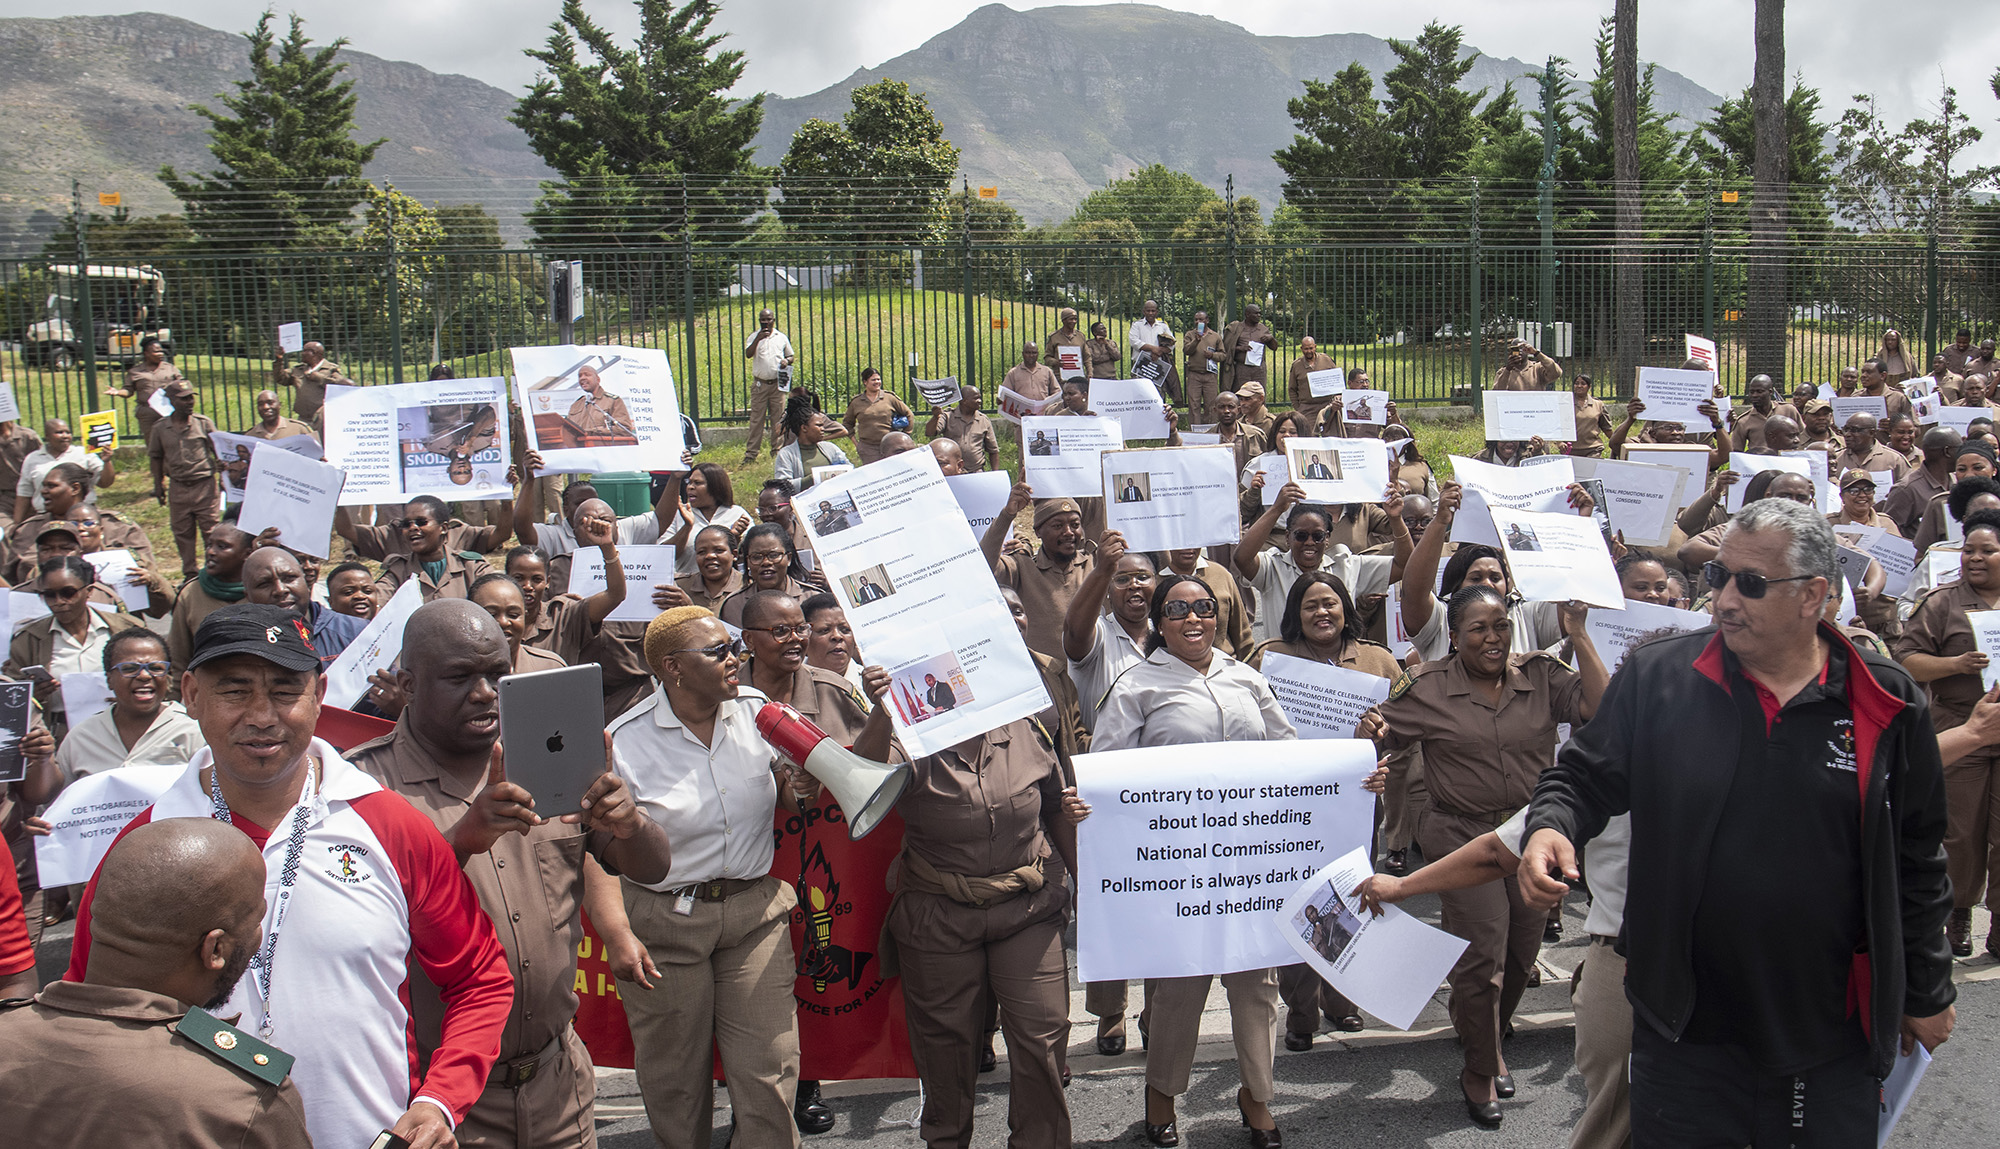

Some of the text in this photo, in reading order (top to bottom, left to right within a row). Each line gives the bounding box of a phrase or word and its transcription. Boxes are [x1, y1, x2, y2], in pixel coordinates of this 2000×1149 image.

[898, 475, 918, 485] DESERVE
[858, 492, 889, 505] PUNISHMENT?
[885, 491, 910, 503] HARDWORK
[911, 483, 931, 494] WITHOUT
[1492, 492, 1534, 501] PROMOTIONS
[1534, 488, 1554, 496] MUST
[863, 508, 879, 517] UNJUST
[890, 497, 912, 507] INHUMAN
[968, 517, 995, 527] OTIO
[930, 560, 946, 568] HOURS
[945, 552, 967, 563] EVERYDAY
[907, 573, 928, 584] WITHOUT
[1604, 623, 1624, 633] POLICIES
[977, 638, 991, 646] WORK
[963, 656, 983, 666] WITHOUT
[966, 650, 978, 658] DAYS
[966, 666, 979, 674] REST?
[1270, 675, 1309, 689] THOBAKGALE
[1311, 685, 1324, 693] YOU
[1337, 690, 1377, 705] CELEBRATING
[1279, 686, 1297, 696] BEING
[1298, 691, 1333, 704] PROMOTED
[1277, 695, 1322, 711] OMMISSIONER,
[1324, 705, 1343, 715] WHILE
[1295, 716, 1311, 725] THAN
[1321, 722, 1340, 732] YEARS
[1302, 709, 1315, 717] ONE
[1316, 712, 1333, 721] RANK
[1347, 719, 1359, 729] MO
[1120, 782, 1340, 805] Contrary to your statement
[72, 806, 88, 815] CDE
[90, 800, 137, 812] THOBAKGALE
[145, 800, 150, 808] A
[56, 814, 121, 830] COMMISSIONER
[773, 804, 848, 850] POPC
[1149, 809, 1312, 830] about load shedding
[80, 827, 117, 839] NOT FOR
[328, 845, 368, 856] POPCRU
[1137, 838, 1324, 861] National Commissioner,
[325, 870, 346, 882] JUSTICE
[1102, 877, 1186, 893] Pollsmoor
[1191, 874, 1203, 889] is
[1208, 872, 1261, 888] always
[1266, 867, 1298, 884] dark
[834, 902, 852, 916] 89
[1177, 896, 1284, 917] load shedding
[795, 978, 885, 1016] TICE FOR ALL
[1792, 1082, 1805, 1128] LEVI'S
